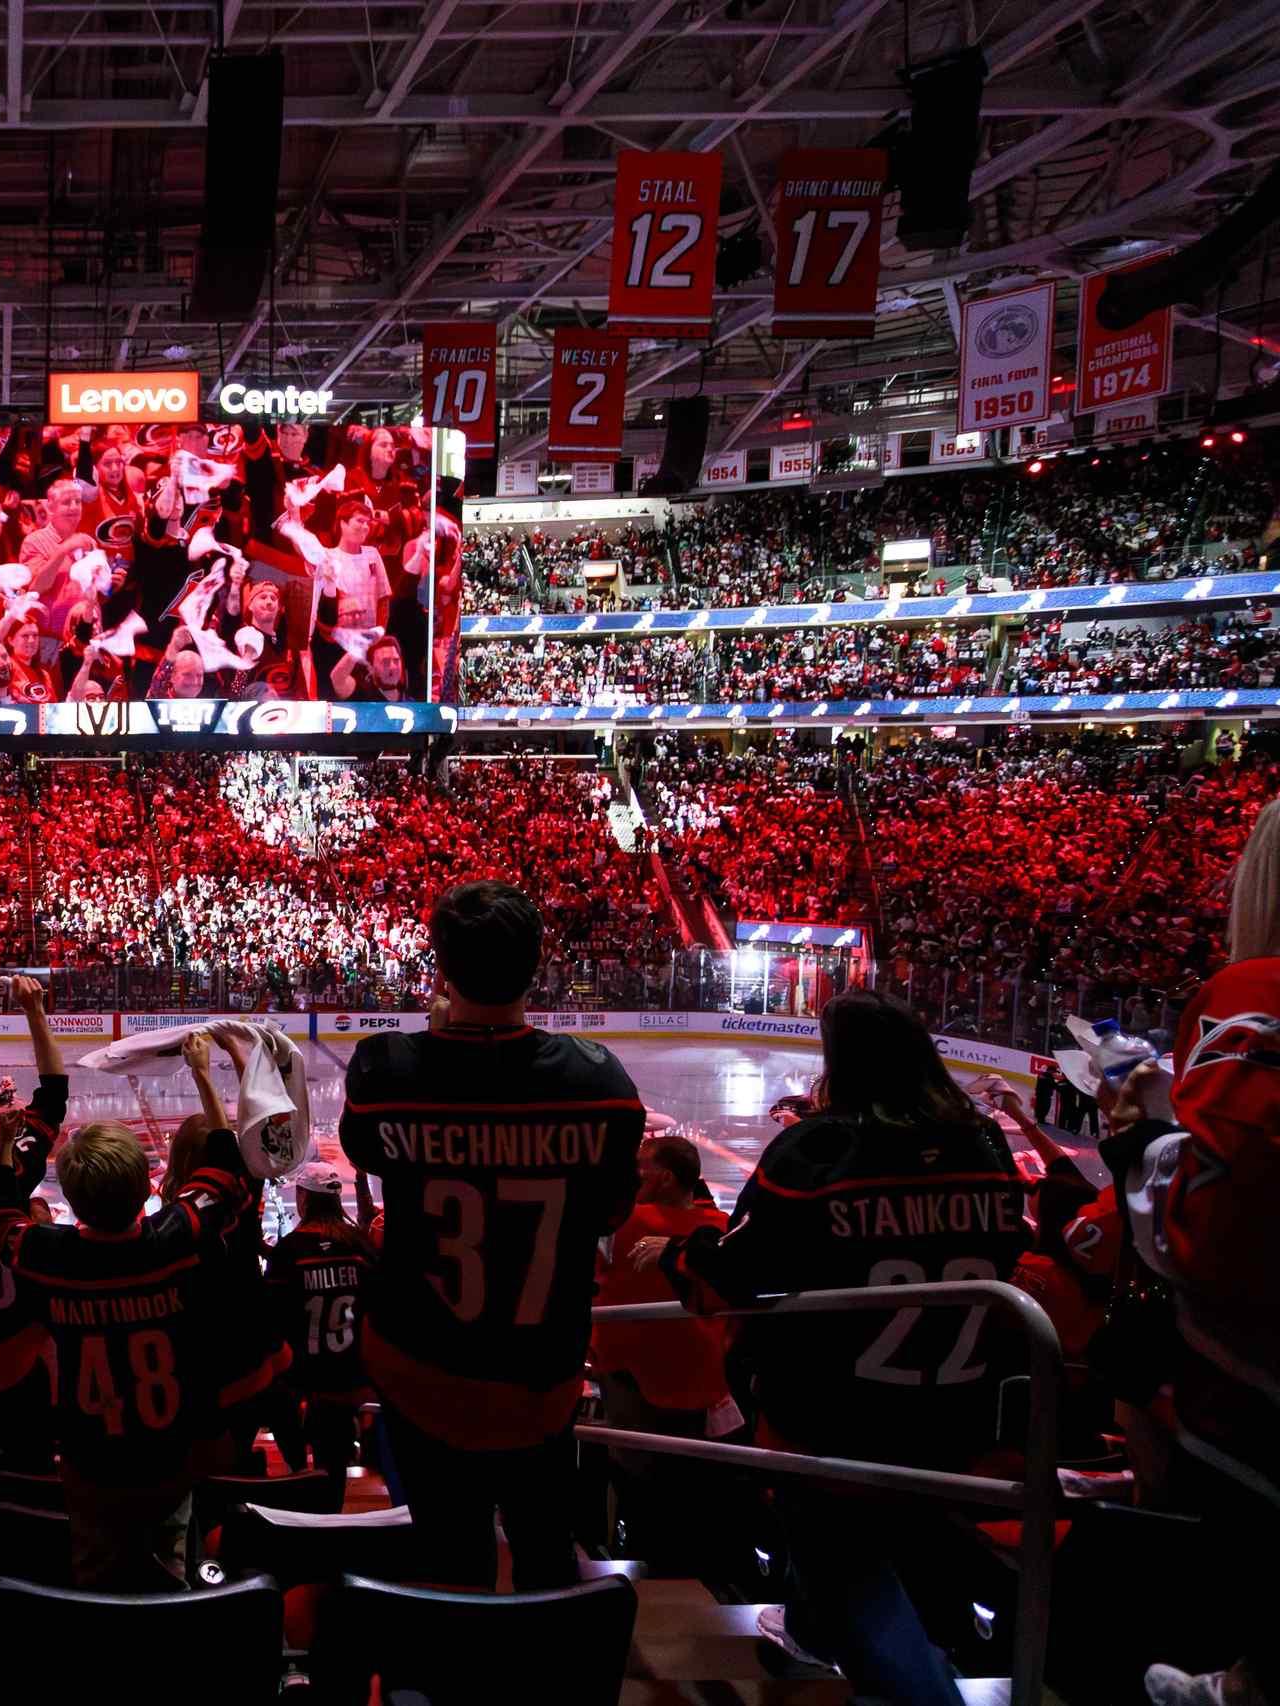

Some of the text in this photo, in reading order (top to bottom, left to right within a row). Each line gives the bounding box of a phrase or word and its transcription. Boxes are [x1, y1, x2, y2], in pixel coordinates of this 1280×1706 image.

[638, 179, 697, 203] STAAL
[626, 212, 703, 288] 12
[788, 210, 871, 286] 17
[429, 348, 491, 364] FRANCIS
[560, 349, 619, 367] WESLEY
[971, 366, 1039, 389] FINAL FOUR
[1093, 363, 1151, 399] 1974
[61, 383, 187, 413] Lenovo
[219, 383, 332, 414] Center
[431, 369, 487, 423] 10
[568, 371, 605, 425] 2
[974, 391, 1034, 421] 1950
[706, 464, 738, 481] 1954
[779, 459, 812, 474] 1955
[48, 1016, 104, 1027] LYNNWOOD
[127, 1016, 158, 1026] RALEIGH
[359, 1018, 401, 1028] PEPSI
[643, 1015, 684, 1025] SILAC
[721, 1017, 818, 1035] ticketmaster
[376, 1119, 609, 1168] SVECHNIKOV
[828, 1190, 1024, 1240] STANKOVE
[420, 1174, 568, 1327] 37
[302, 1264, 358, 1291] MILLER
[47, 1288, 186, 1329] MARTINOOK
[853, 1256, 999, 1387] 22
[303, 1295, 355, 1357] 19
[74, 1329, 184, 1440] 48
